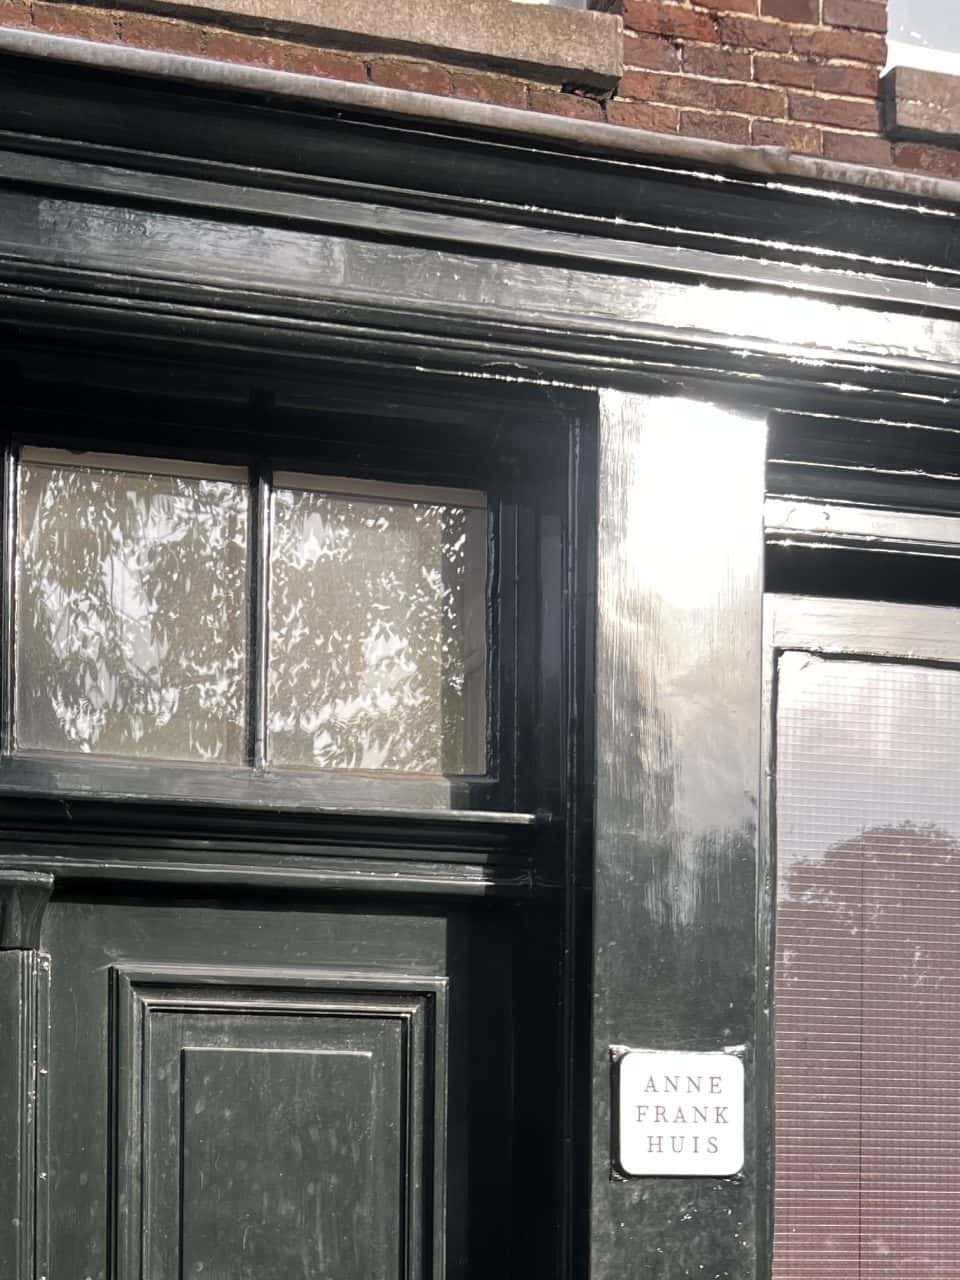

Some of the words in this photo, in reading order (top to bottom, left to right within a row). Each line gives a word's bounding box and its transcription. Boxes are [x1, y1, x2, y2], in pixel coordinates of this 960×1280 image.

[644, 1074, 722, 1094] ANNE
[636, 1105, 729, 1124] FRANK
[647, 1135, 719, 1154] HUIS
